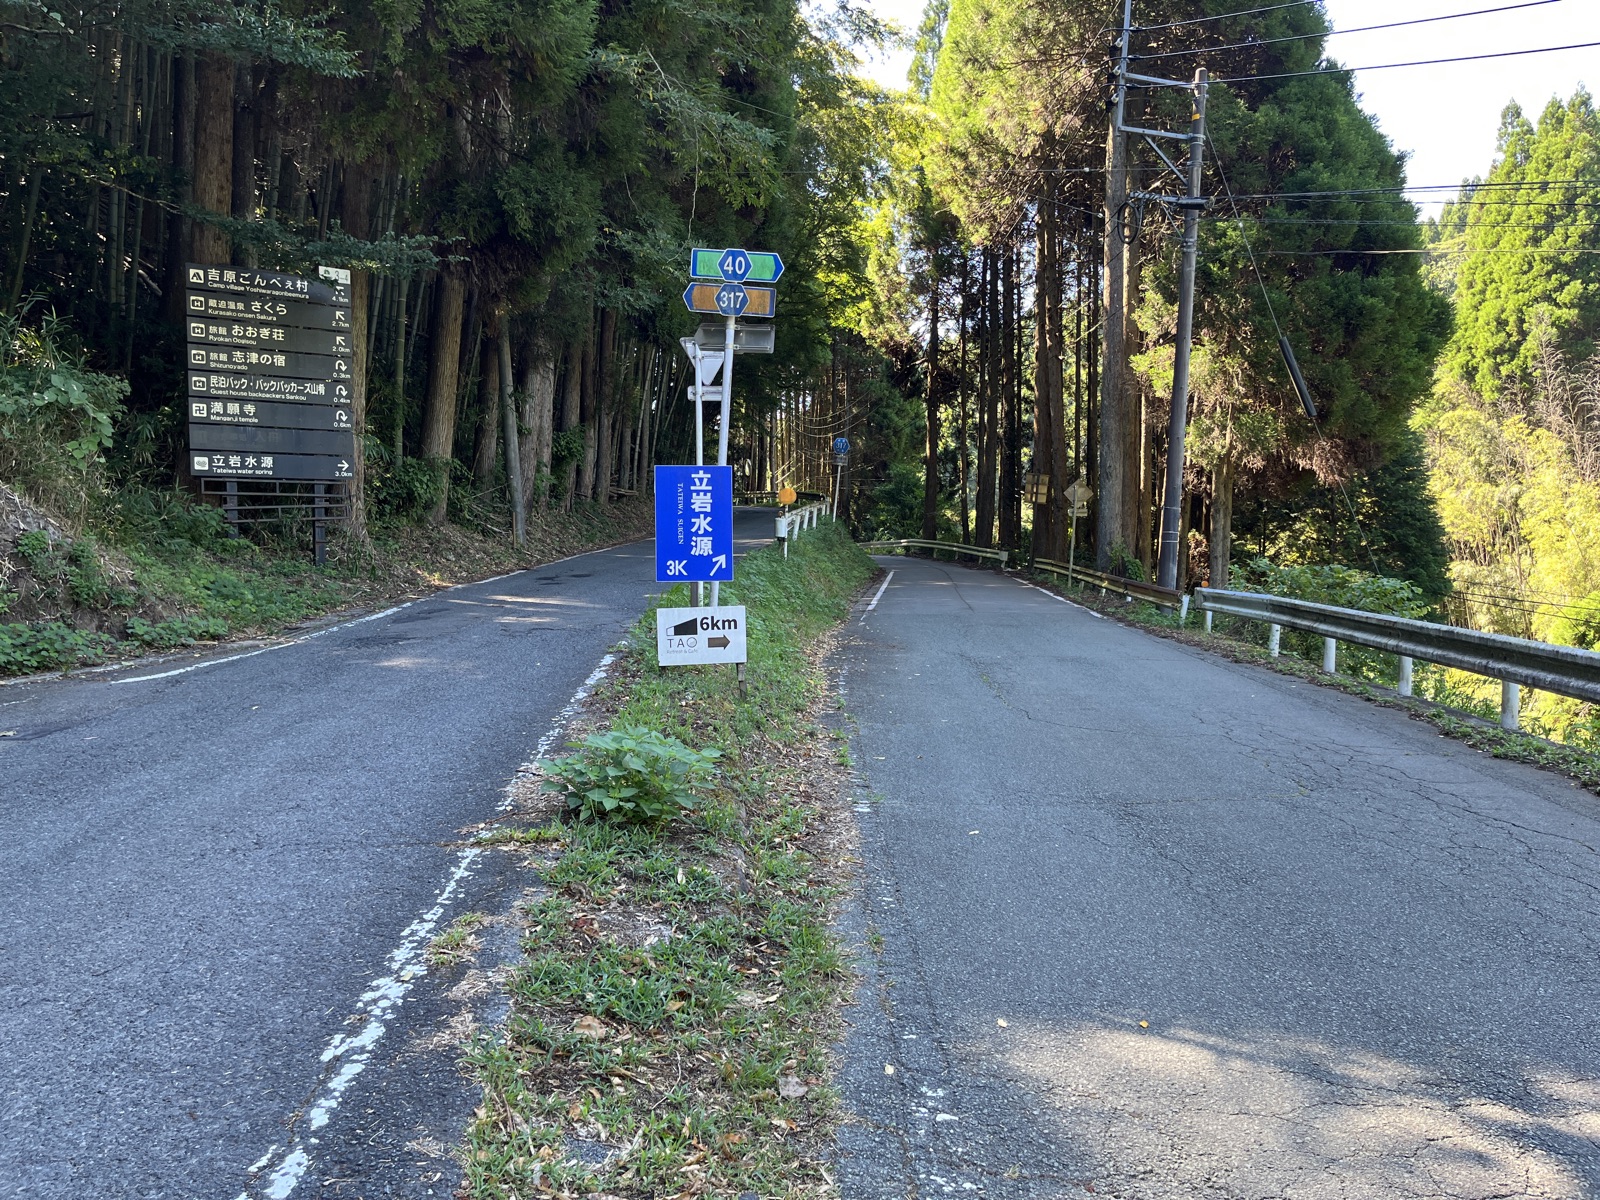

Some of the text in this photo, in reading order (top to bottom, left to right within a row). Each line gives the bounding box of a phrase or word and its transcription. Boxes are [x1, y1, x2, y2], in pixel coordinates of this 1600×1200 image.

[723, 256, 746, 275] 40
[208, 281, 226, 289] Camp
[226, 283, 246, 293] village
[720, 291, 744, 309] 317
[250, 301, 288, 315] さくら
[208, 309, 237, 317] Kurasako
[237, 312, 256, 320] onsen
[331, 321, 350, 329] 2.7km
[208, 325, 285, 342] 旅館 おおぎ荘
[208, 335, 232, 344] Ryokan
[332, 346, 351, 354] 2.0km
[209, 350, 286, 368] 旅館 志津の宿
[210, 362, 248, 371] Shizunoyado
[332, 372, 351, 380] 0.3km
[210, 388, 229, 396] Guest
[229, 389, 249, 397] house
[247, 391, 285, 400] backpackers
[332, 397, 351, 405] 0.4km
[210, 401, 257, 417] 満願寺
[209, 414, 258, 424] Manganji temple
[212, 454, 274, 470] 立岩水源
[212, 467, 274, 477] Tateiwa water spring
[334, 471, 353, 479] 3.0km
[676, 482, 685, 546] TATEIWA SUIGEN
[690, 469, 713, 557] 立岩水源
[666, 559, 689, 577] 3K
[699, 615, 739, 632] 6km
[666, 637, 699, 649] TAO
